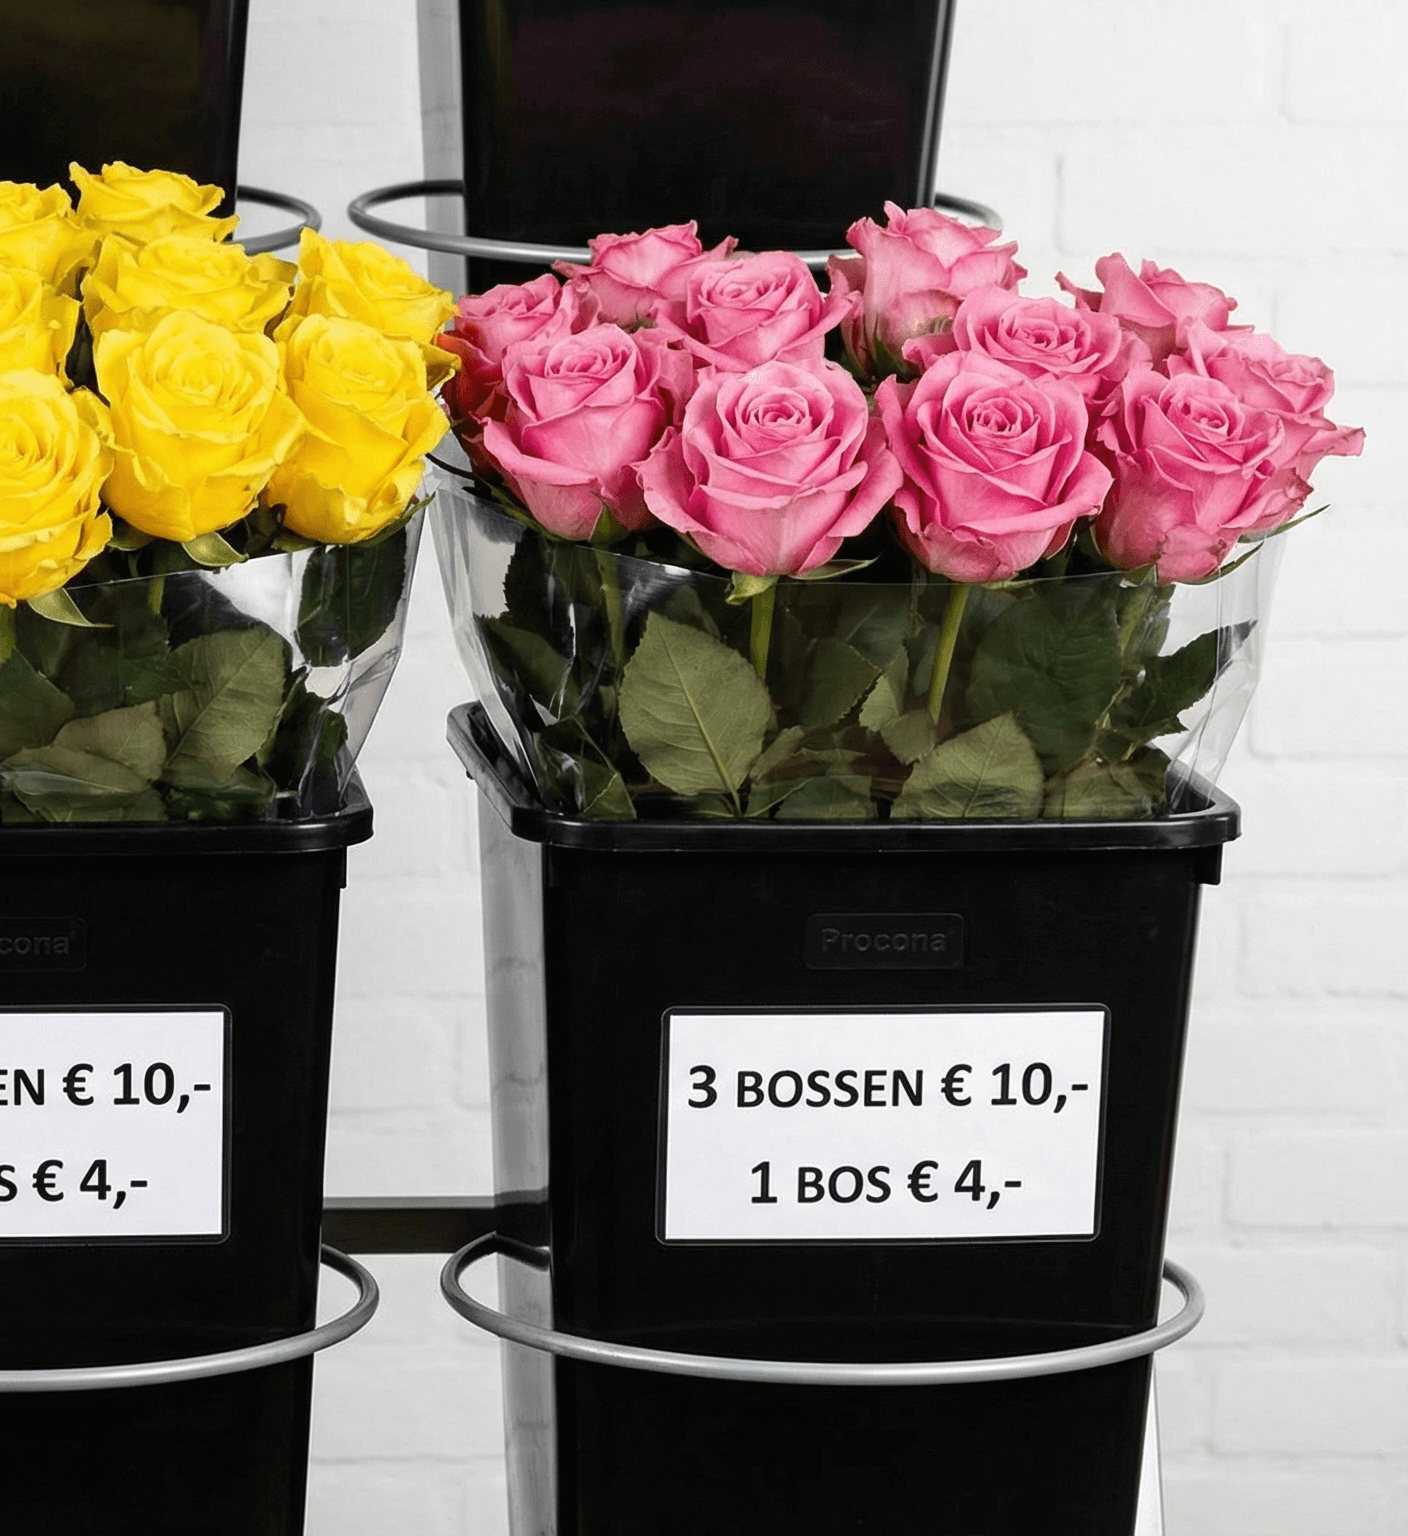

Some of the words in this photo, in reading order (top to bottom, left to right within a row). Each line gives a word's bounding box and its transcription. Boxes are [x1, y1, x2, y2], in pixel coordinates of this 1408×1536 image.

[62, 1063, 95, 1107] €
[112, 1062, 211, 1114] 10,-
[687, 1064, 718, 1109] 3
[736, 1069, 924, 1109] BOSSEN
[940, 1063, 973, 1107] €
[990, 1062, 1089, 1114] 10,-
[32, 1159, 64, 1202] €
[79, 1159, 148, 1210] 4,-
[750, 1161, 778, 1204] 1
[797, 1165, 892, 1204] BOS
[906, 1160, 939, 1203] €
[954, 1159, 1022, 1210] 4,-
